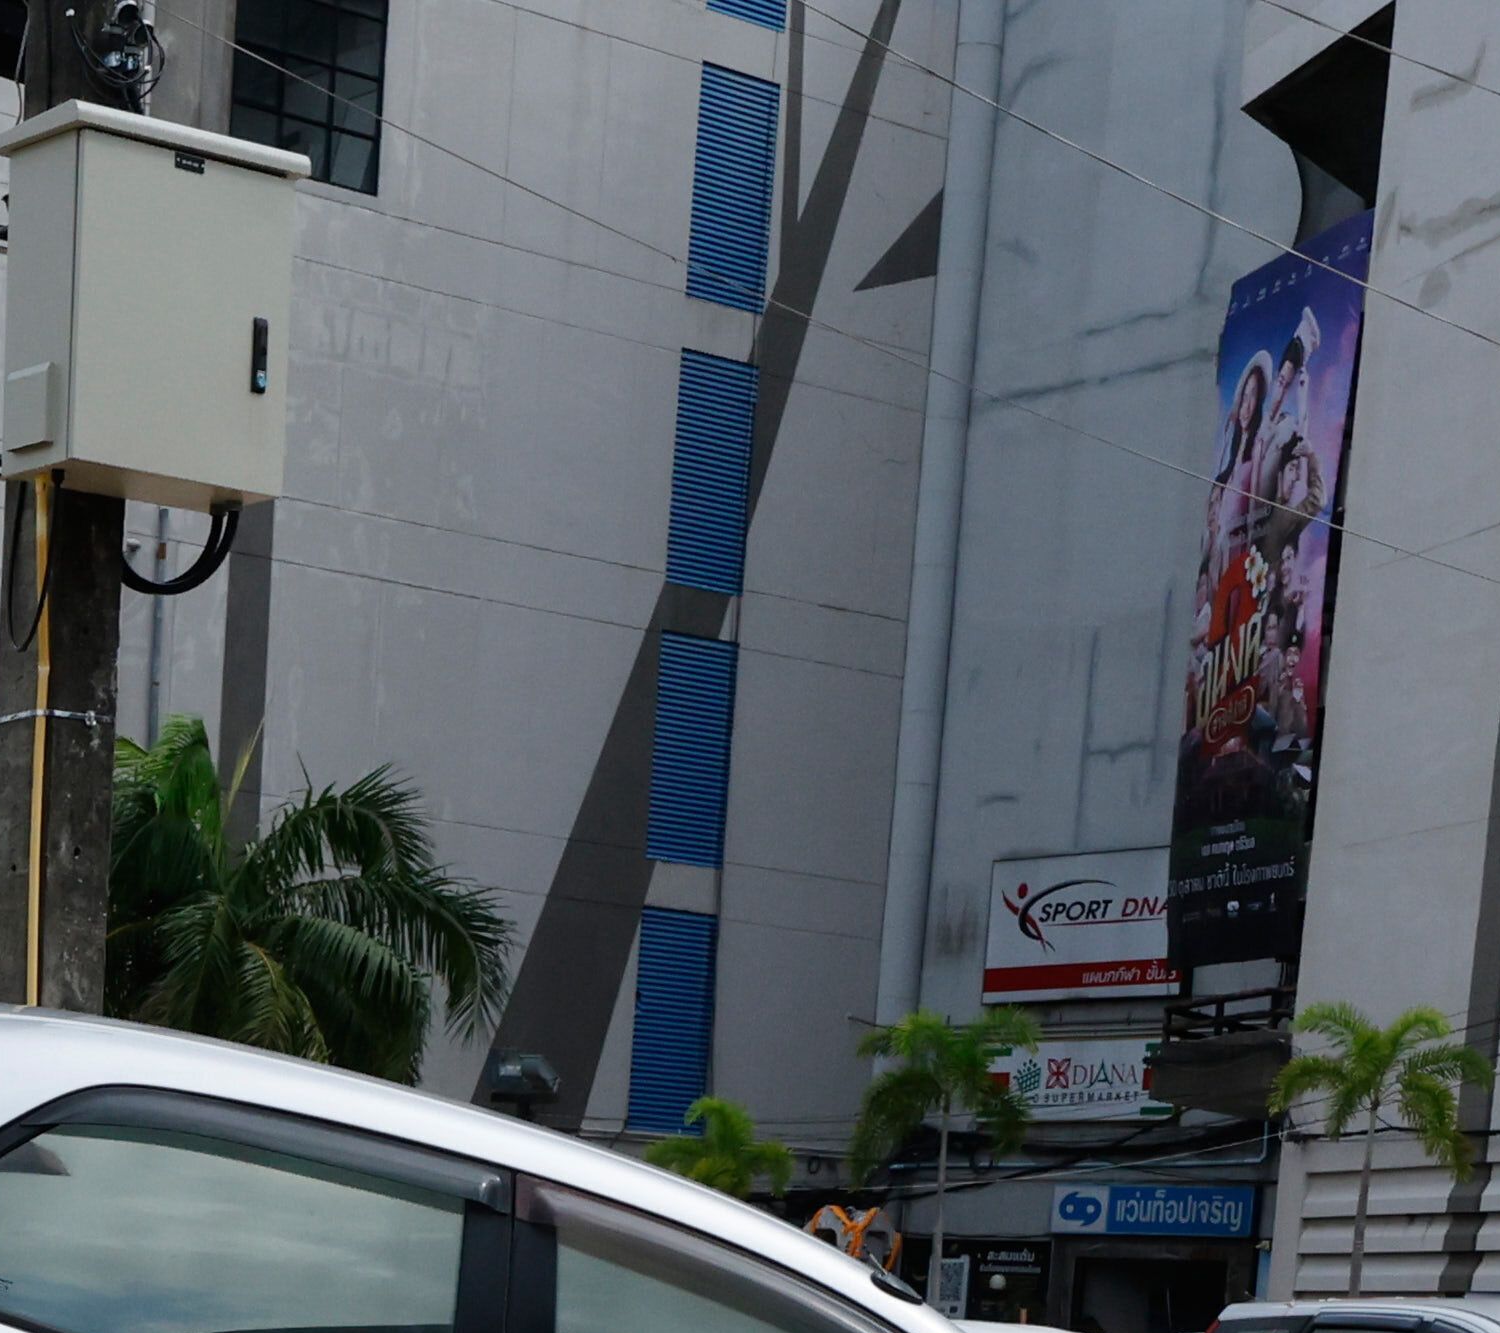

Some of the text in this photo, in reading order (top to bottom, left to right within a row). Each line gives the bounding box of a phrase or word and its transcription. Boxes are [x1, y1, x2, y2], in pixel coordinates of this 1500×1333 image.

[1040, 899, 1113, 923] SPORT
[1072, 1058, 1138, 1089] DIANA
[1044, 1090, 1139, 1104] SUPERMARKET
[1115, 1190, 1243, 1232] แว่นท็อปเจริญ
